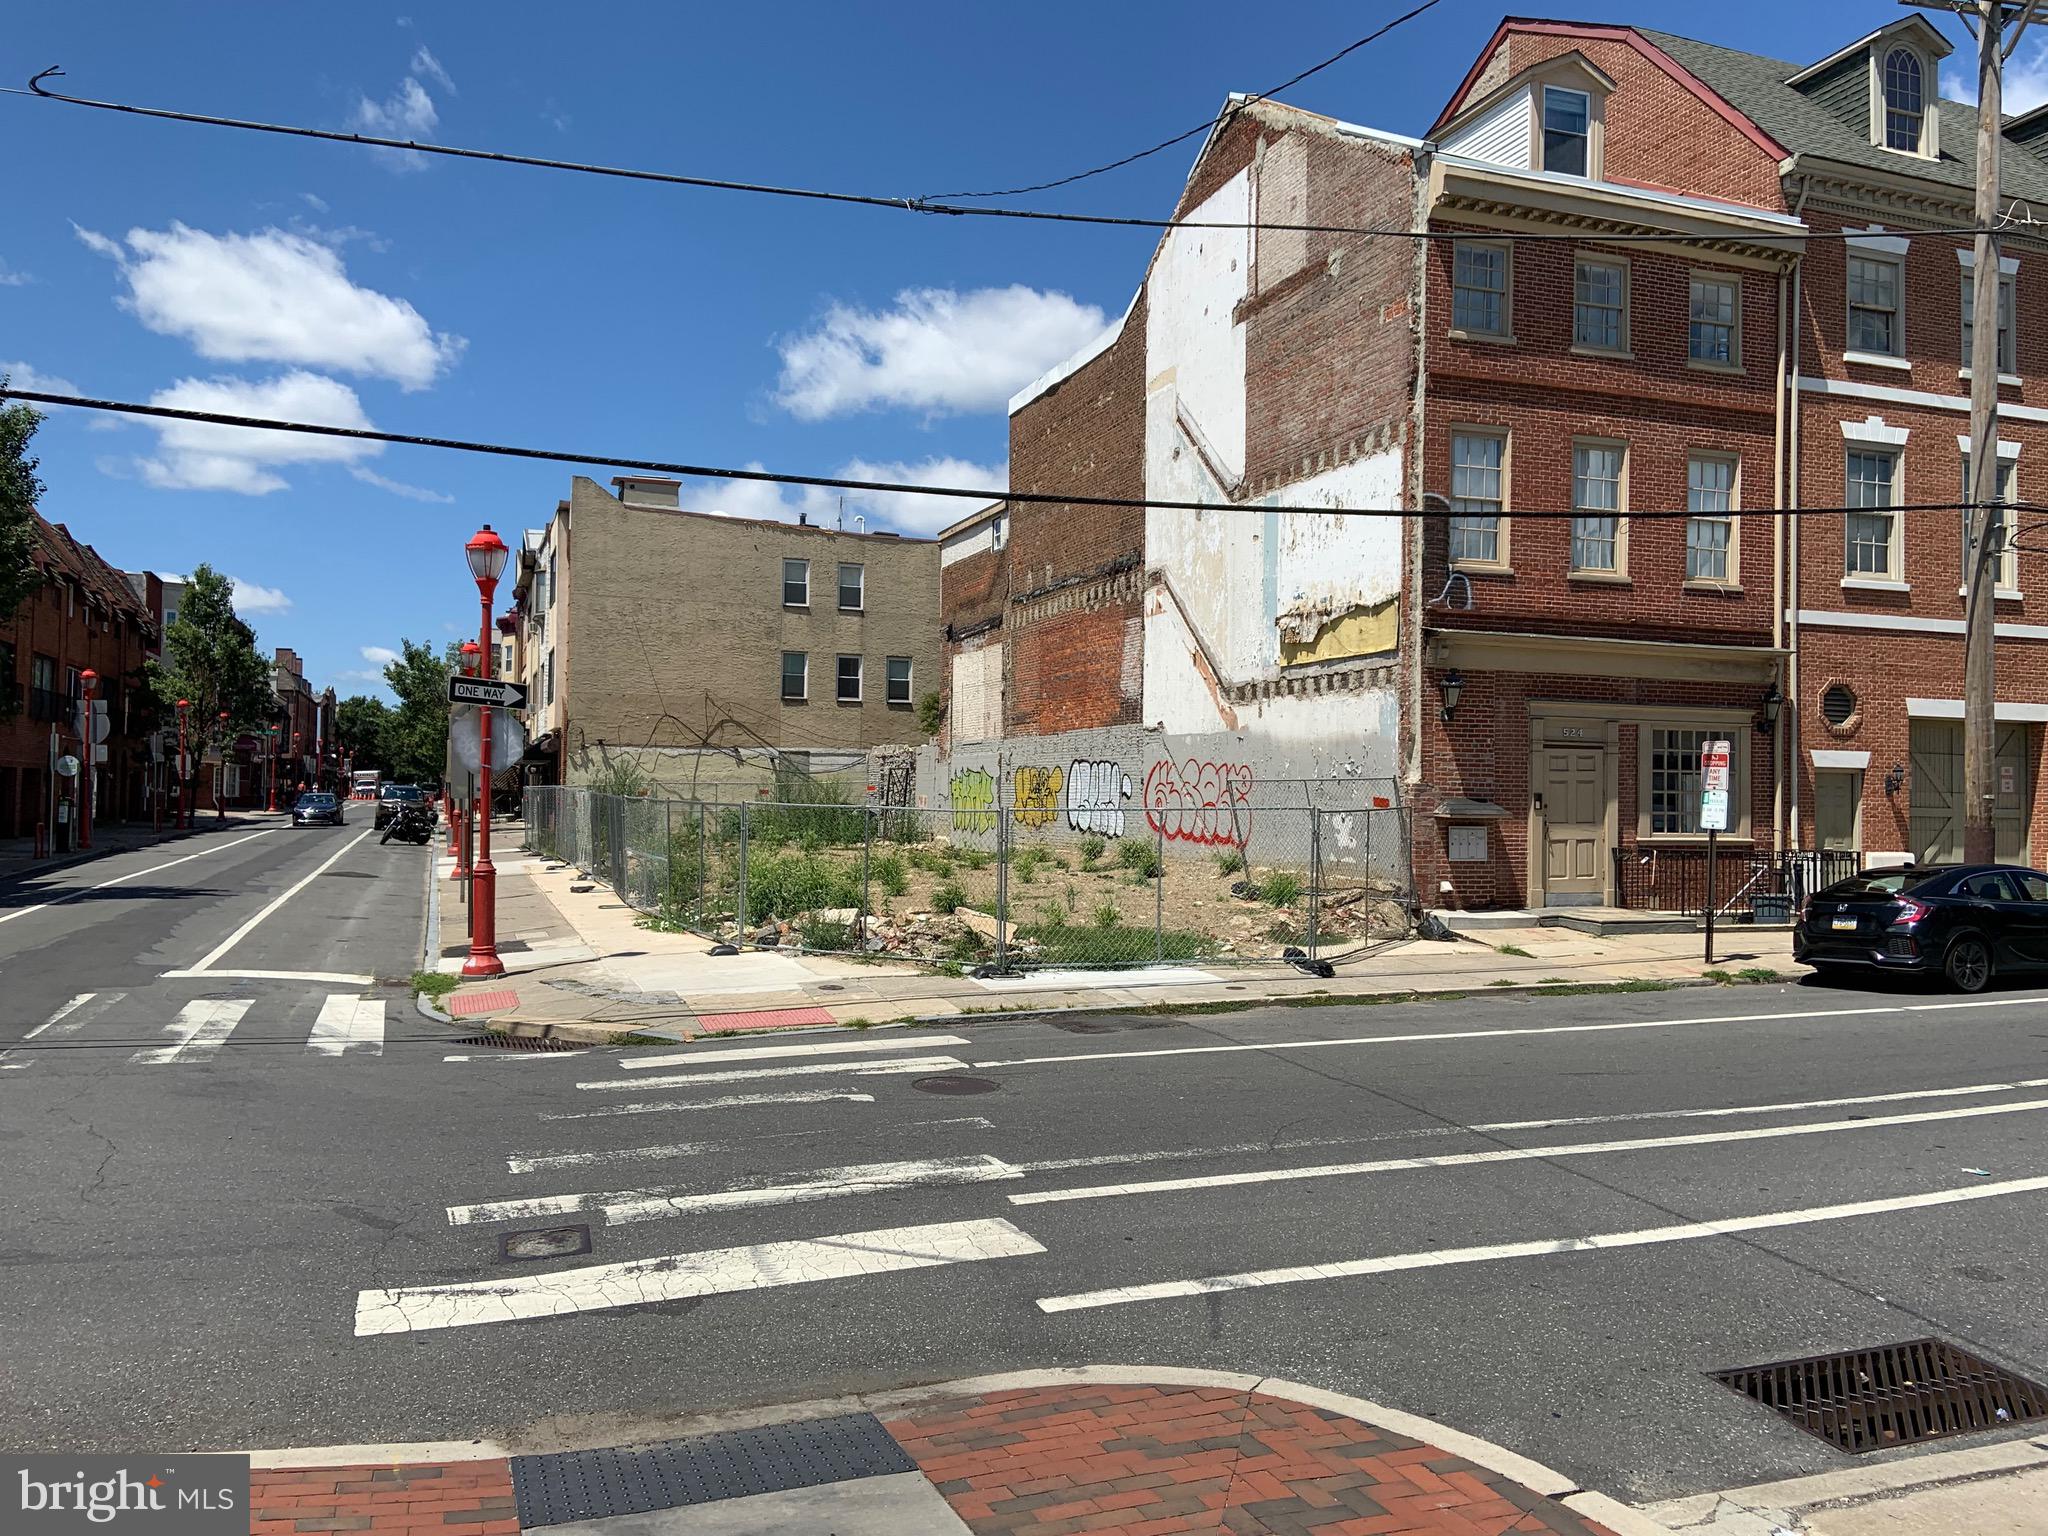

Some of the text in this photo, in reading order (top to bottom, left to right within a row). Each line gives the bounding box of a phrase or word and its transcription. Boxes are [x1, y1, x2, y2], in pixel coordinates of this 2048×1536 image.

[457, 685, 505, 699] ONE WAY
[1563, 728, 1583, 737] 524
